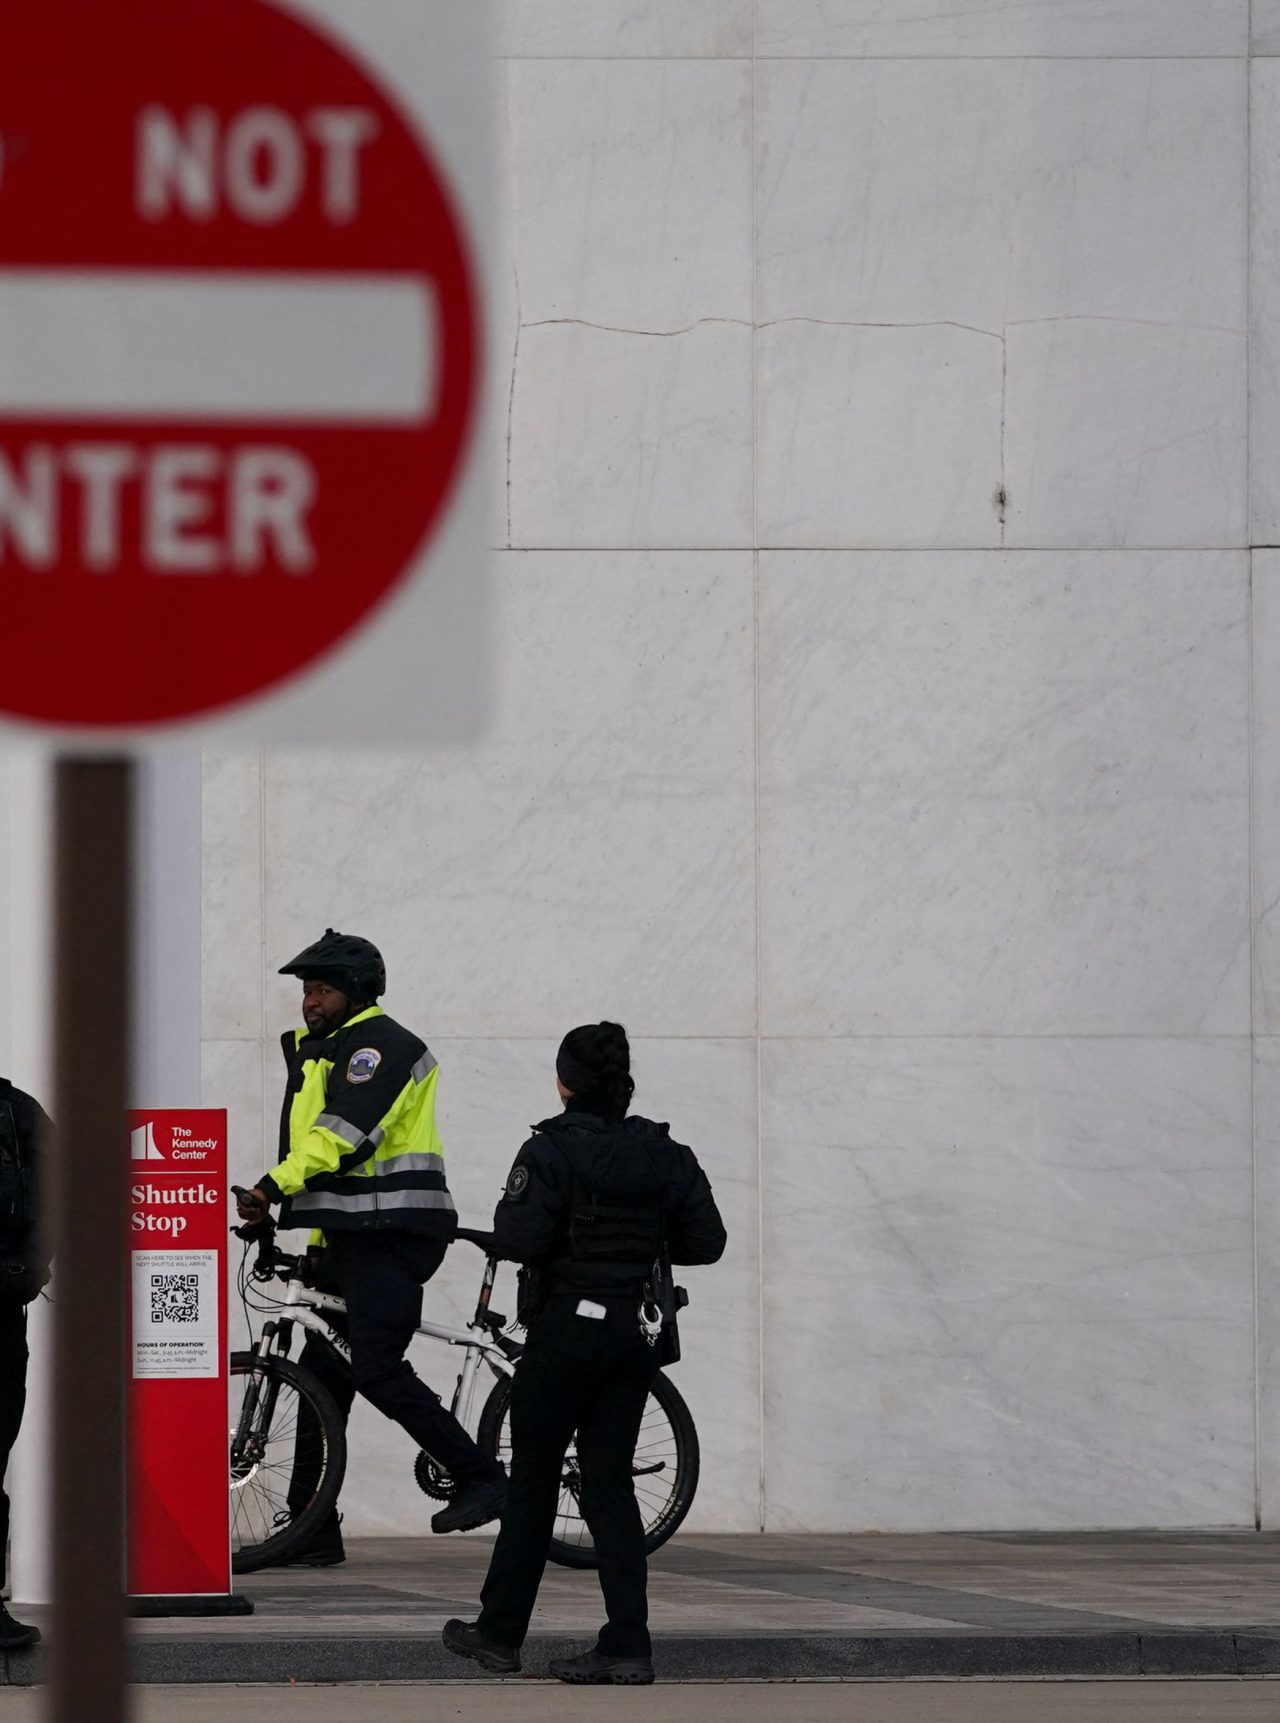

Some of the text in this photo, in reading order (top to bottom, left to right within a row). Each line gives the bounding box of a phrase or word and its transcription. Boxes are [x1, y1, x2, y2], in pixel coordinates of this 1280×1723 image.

[136, 104, 380, 222] NOT
[172, 1127, 192, 1137] The
[172, 1138, 218, 1150] Kennedy
[172, 1150, 208, 1160] Center
[131, 1184, 219, 1205] Shuttle
[131, 1211, 187, 1238] Stop
